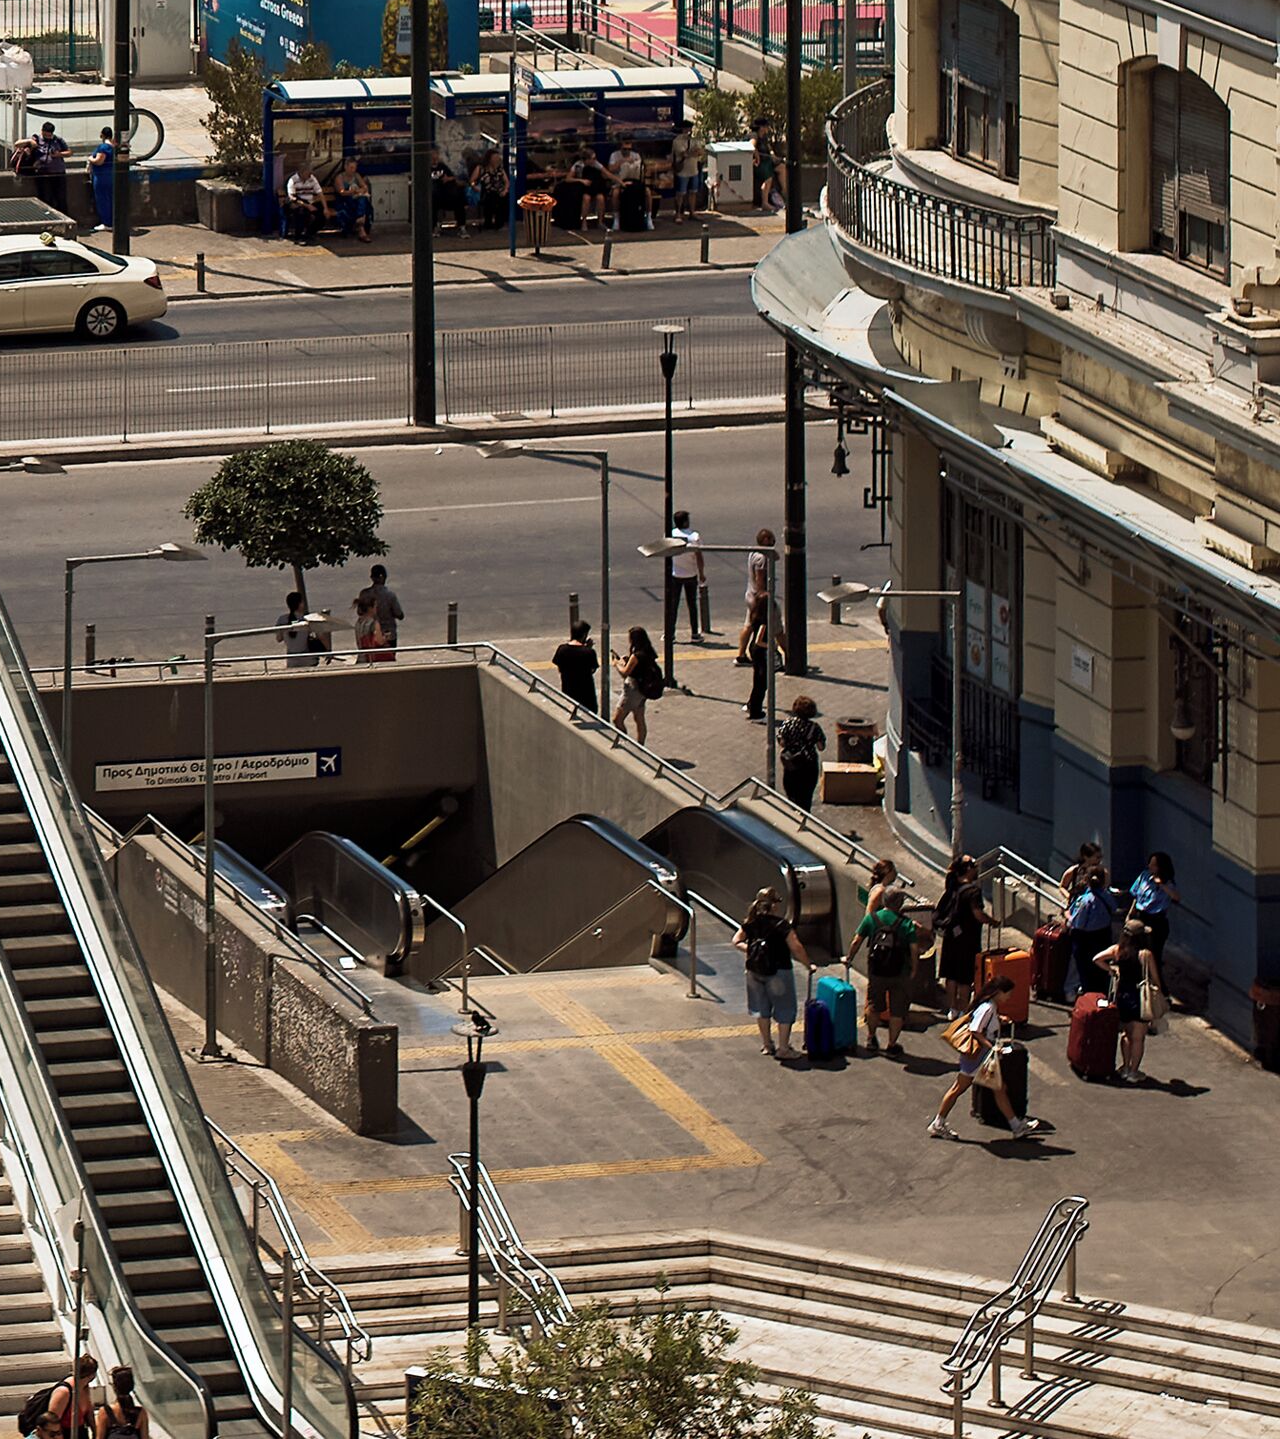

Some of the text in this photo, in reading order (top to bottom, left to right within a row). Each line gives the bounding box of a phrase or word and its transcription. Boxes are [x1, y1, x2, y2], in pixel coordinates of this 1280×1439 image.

[281, 3, 304, 28] Greece
[102, 756, 309, 779] Προς Δημοτικό Θέτρο / Αεροδρόμιο
[145, 778, 156, 786] To
[157, 774, 196, 785] Dimotiko
[237, 771, 268, 782] Airport
